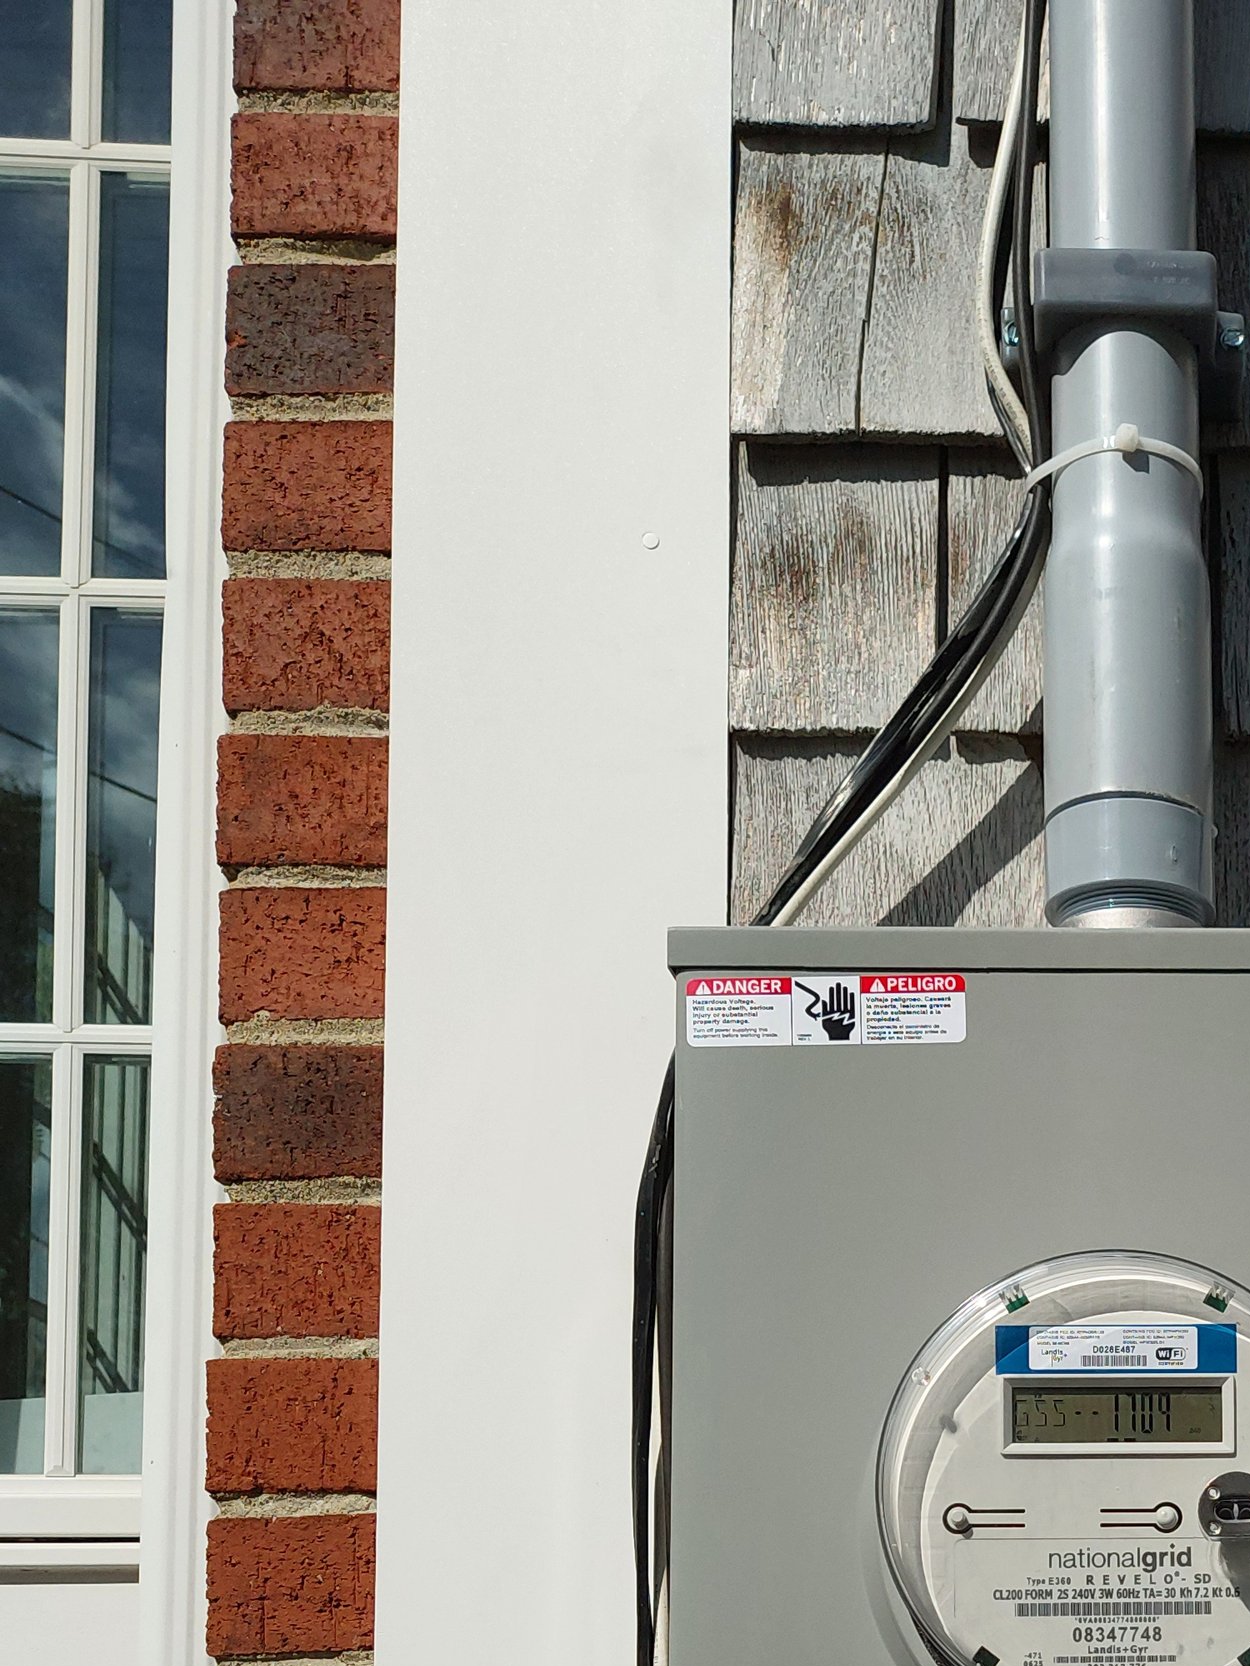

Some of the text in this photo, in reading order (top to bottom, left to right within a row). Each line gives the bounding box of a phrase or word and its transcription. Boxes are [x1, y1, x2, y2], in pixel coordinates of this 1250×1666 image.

[712, 979, 782, 994] DANGER
[886, 977, 956, 993] PELIGRO
[1048, 1543, 1192, 1573] nationalgrid
[1027, 1577, 1046, 1586] Type
[1048, 1577, 1071, 1586] E360
[1194, 1573, 1212, 1584] SD
[993, 1589, 1023, 1600] CL200
[1024, 1589, 1053, 1600] FORM
[1057, 1588, 1069, 1599] 2S
[1071, 1588, 1096, 1599] 240V
[1098, 1588, 1114, 1599] 3W
[1116, 1588, 1140, 1599] 60Hz
[1180, 1586, 1192, 1598] Kh
[1194, 1587, 1210, 1598] 7.2
[1212, 1587, 1223, 1598] Kt
[1225, 1586, 1240, 1598] 0.6
[1072, 1626, 1162, 1643] 08347748
[1087, 1645, 1149, 1656] Landis+Gyr
